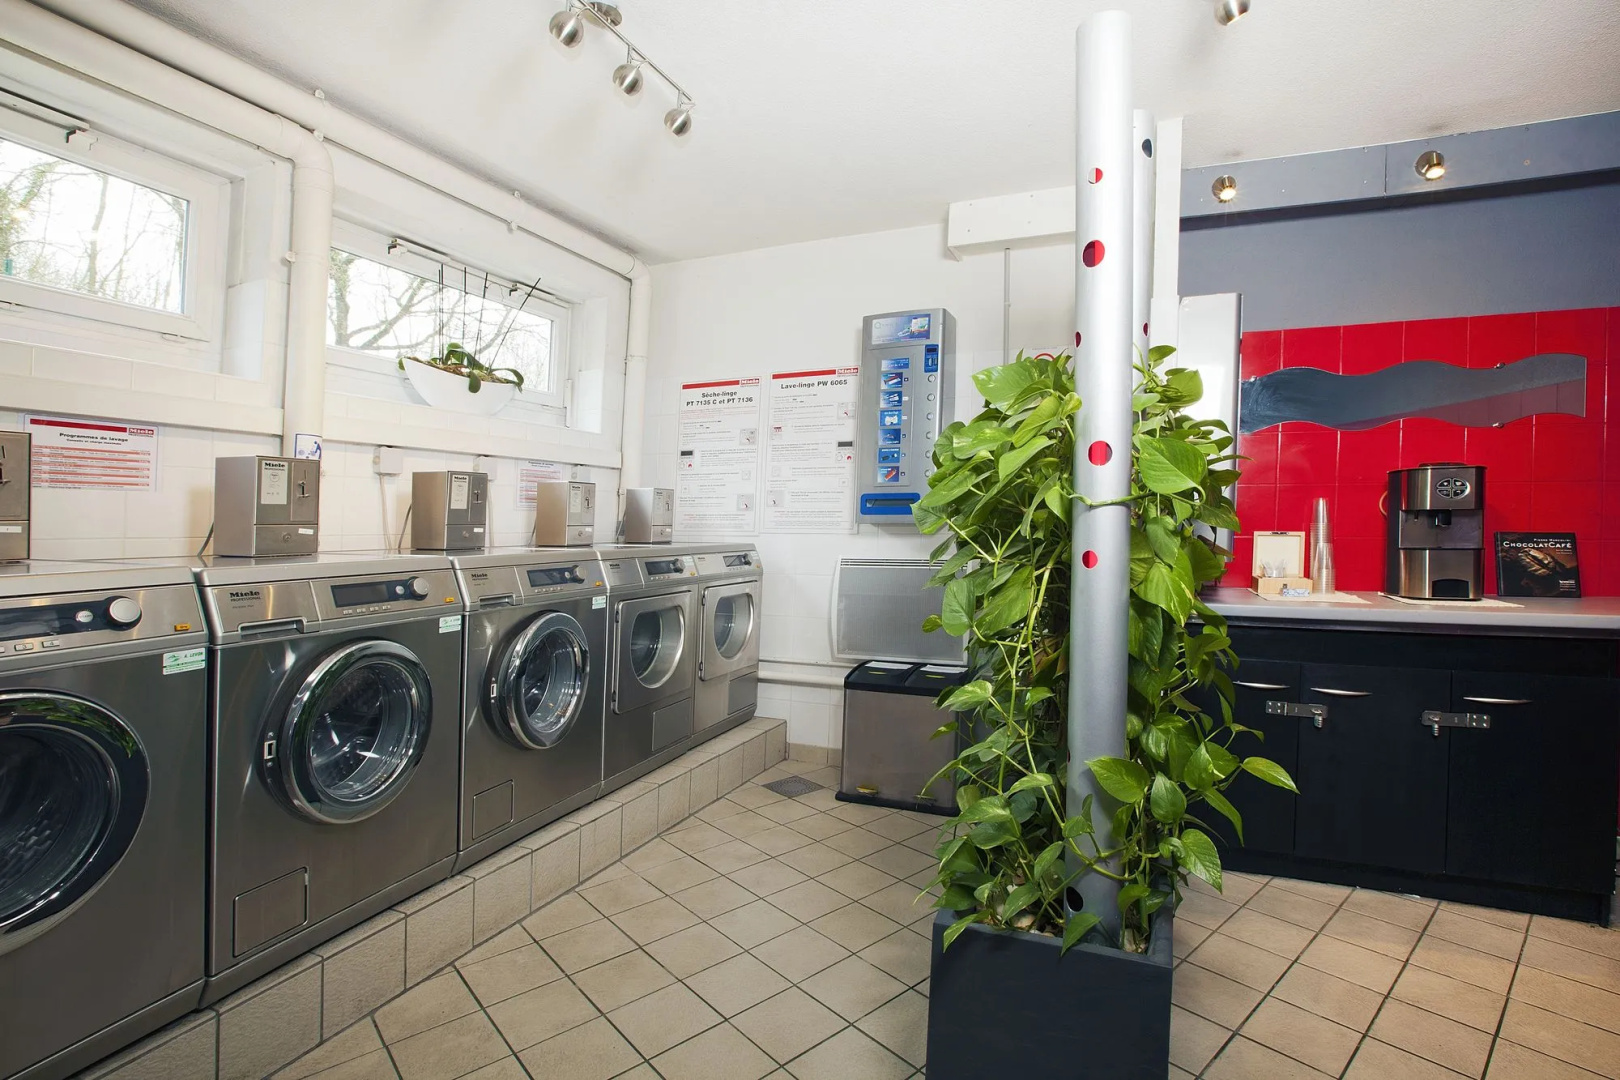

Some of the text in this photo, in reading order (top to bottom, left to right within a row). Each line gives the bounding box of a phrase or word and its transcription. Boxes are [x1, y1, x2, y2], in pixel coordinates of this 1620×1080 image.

[780, 381, 815, 390] Lave-linge
[701, 390, 738, 398] Sèche-linge
[59, 432, 98, 440] Programmes
[229, 590, 260, 598] Miele
